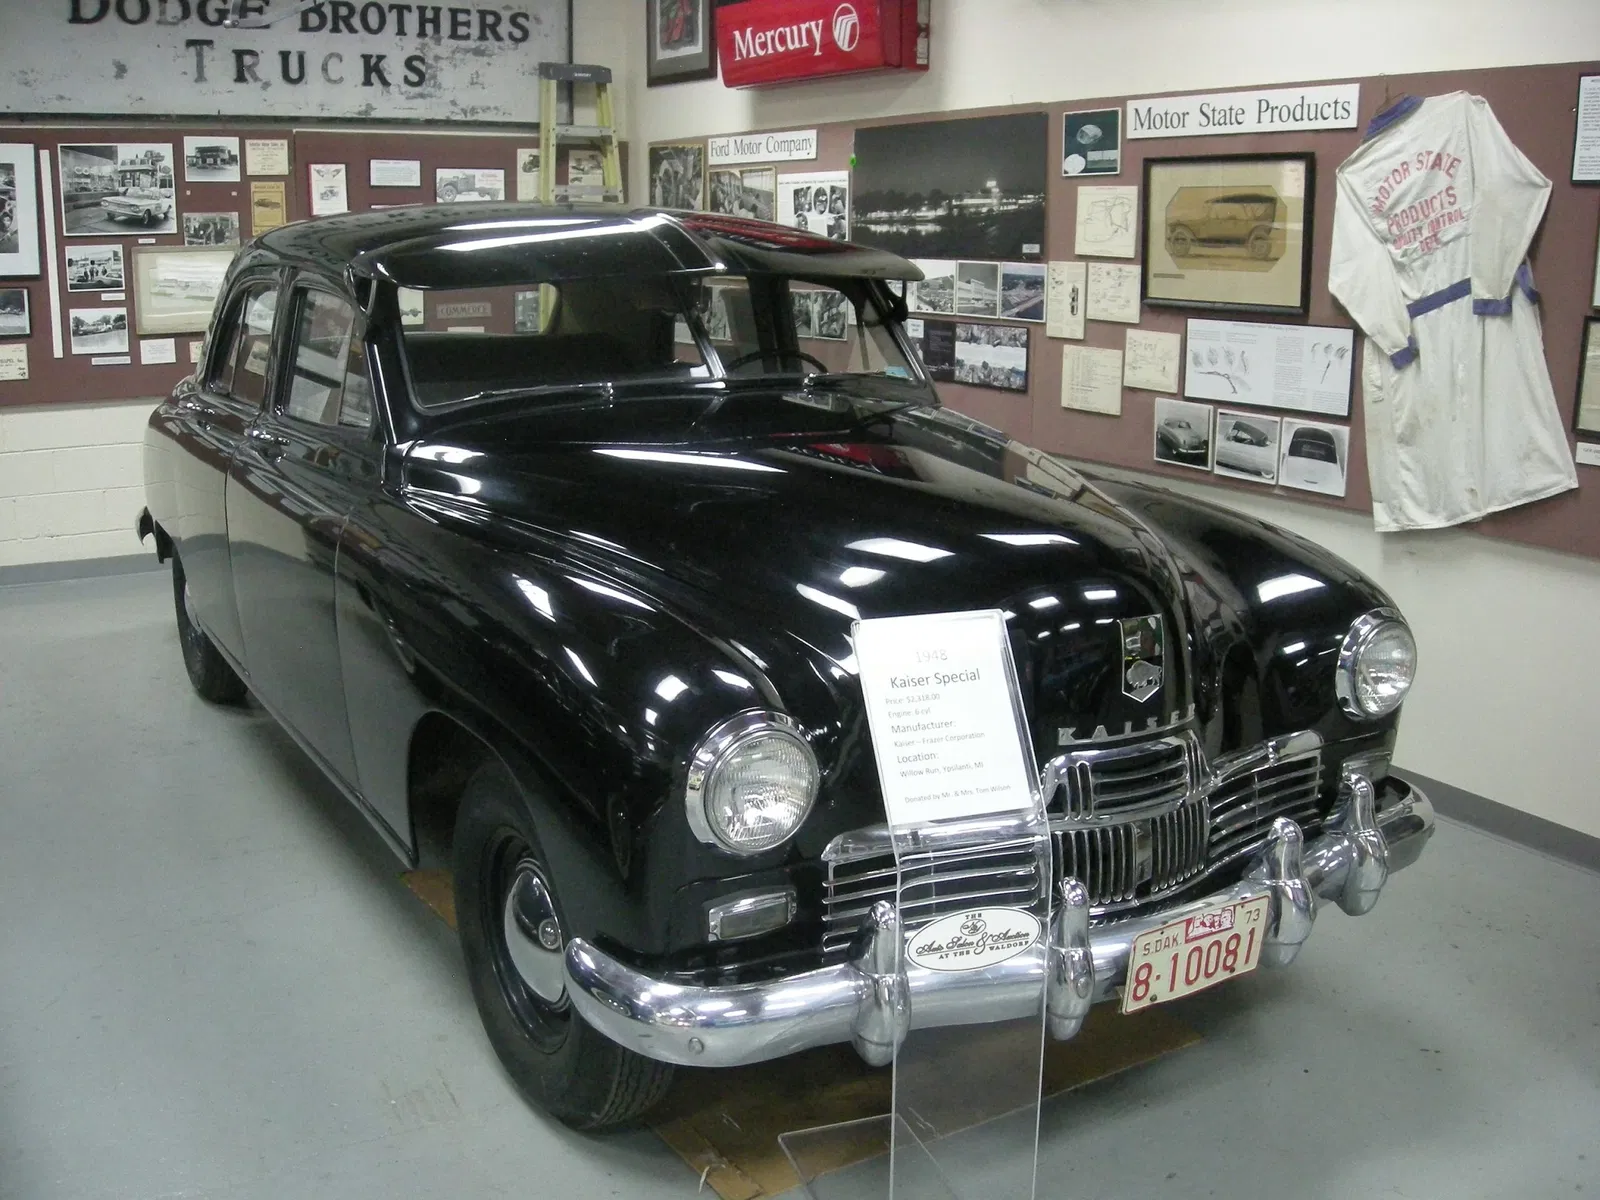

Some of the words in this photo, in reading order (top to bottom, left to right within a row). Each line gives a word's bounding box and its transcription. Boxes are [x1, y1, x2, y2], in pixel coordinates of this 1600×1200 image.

[68, 0, 271, 28] DODGE
[298, 0, 530, 43] BROTHERS
[733, 19, 823, 60] Mercury
[185, 39, 427, 87] TRUCKS
[1133, 106, 1189, 131] Motor
[1199, 102, 1245, 128] State
[1256, 95, 1351, 124] Products
[710, 140, 730, 157] Ford
[734, 138, 762, 156] Motor
[766, 135, 814, 156] Company
[1372, 161, 1411, 216] MOTOR
[1416, 150, 1462, 179] STATE
[1387, 185, 1457, 236] PRODUCTS
[916, 649, 948, 663] 1948
[890, 675, 930, 689] Kaiser
[934, 668, 980, 686] Special
[891, 720, 956, 734] Manufacturer:
[1058, 703, 1195, 745] KAISER
[894, 739, 914, 747] Kaiser
[922, 736, 943, 745] Frazer
[945, 732, 985, 743] Corporation
[897, 752, 939, 764] Location:
[900, 768, 924, 778] Willow
[925, 766, 941, 775] Run,
[974, 761, 984, 769] MI
[905, 793, 931, 803] Donated
[933, 793, 941, 801] by
[954, 790, 960, 798] &
[976, 786, 989, 794] Tom
[990, 784, 1011, 793] Wilson
[965, 912, 982, 920] THE
[915, 940, 944, 954] Auto
[946, 935, 975, 950] Salon
[973, 932, 992, 955] &
[991, 928, 1030, 943] Auction
[1143, 932, 1182, 956] S.DAK.
[1244, 908, 1261, 924] 73
[989, 940, 1029, 951] WALDORF
